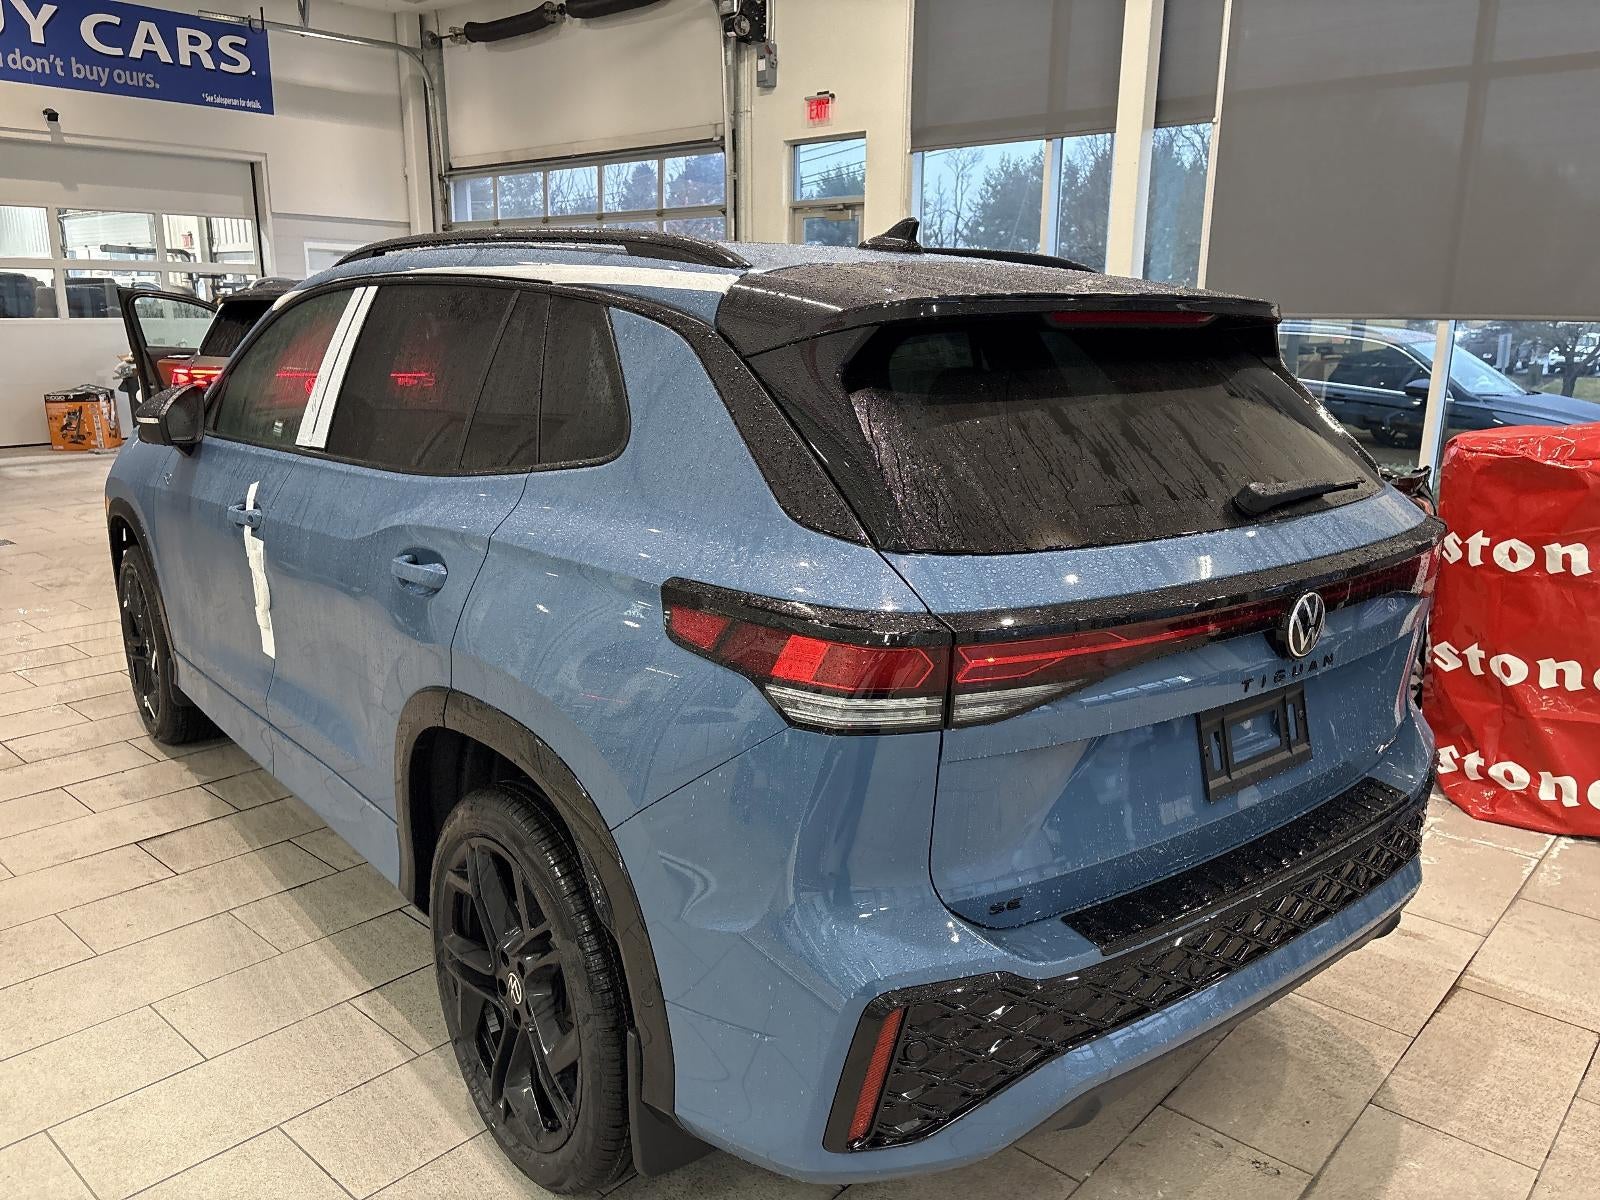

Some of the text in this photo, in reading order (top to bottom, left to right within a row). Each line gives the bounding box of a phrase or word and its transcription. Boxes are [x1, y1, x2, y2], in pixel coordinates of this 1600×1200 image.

[7, 48, 65, 77] don't
[71, 57, 110, 87] buy
[112, 67, 160, 90] ours.
[809, 100, 830, 120] EXIT
[1241, 653, 1334, 693] TIGUAN
[1432, 640, 1600, 692] ston
[989, 897, 1023, 915] SE
